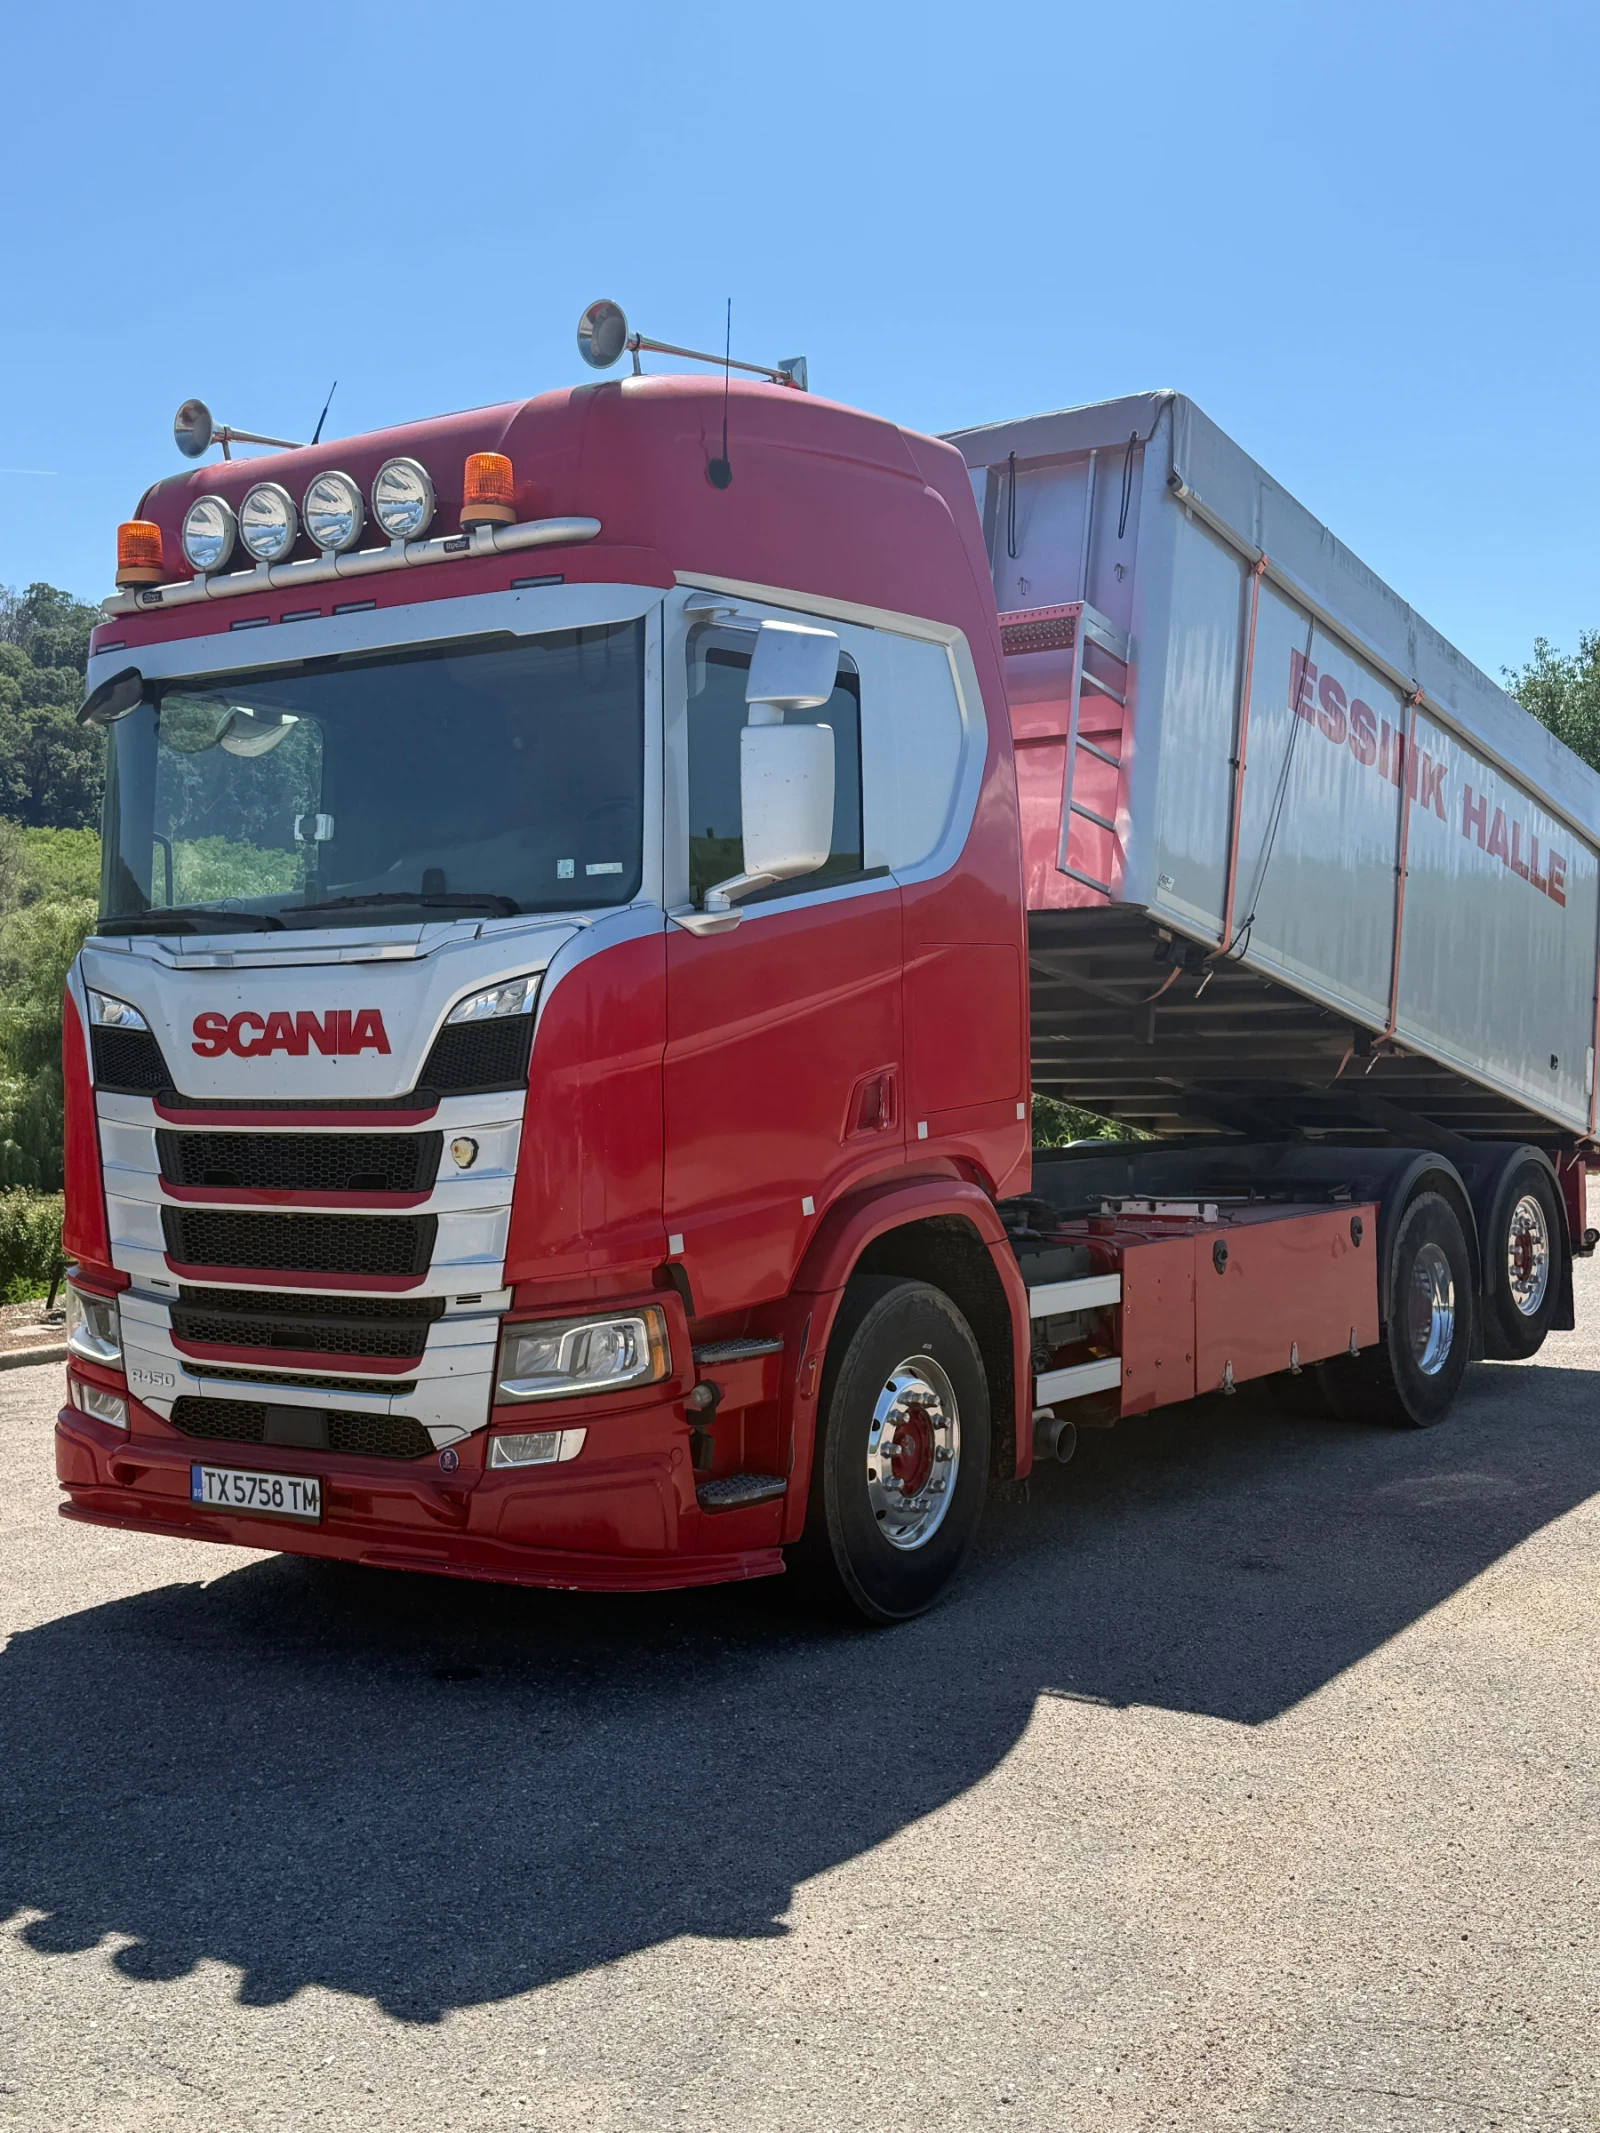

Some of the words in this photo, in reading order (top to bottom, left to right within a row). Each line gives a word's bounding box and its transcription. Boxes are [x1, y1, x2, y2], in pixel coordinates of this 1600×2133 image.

[1462, 784, 1566, 908] HALLE
[191, 1009, 392, 1058] SCANIA
[131, 1368, 175, 1387] R450
[204, 1471, 230, 1502] TX
[233, 1475, 284, 1508] 5758
[288, 1480, 319, 1512] TM
